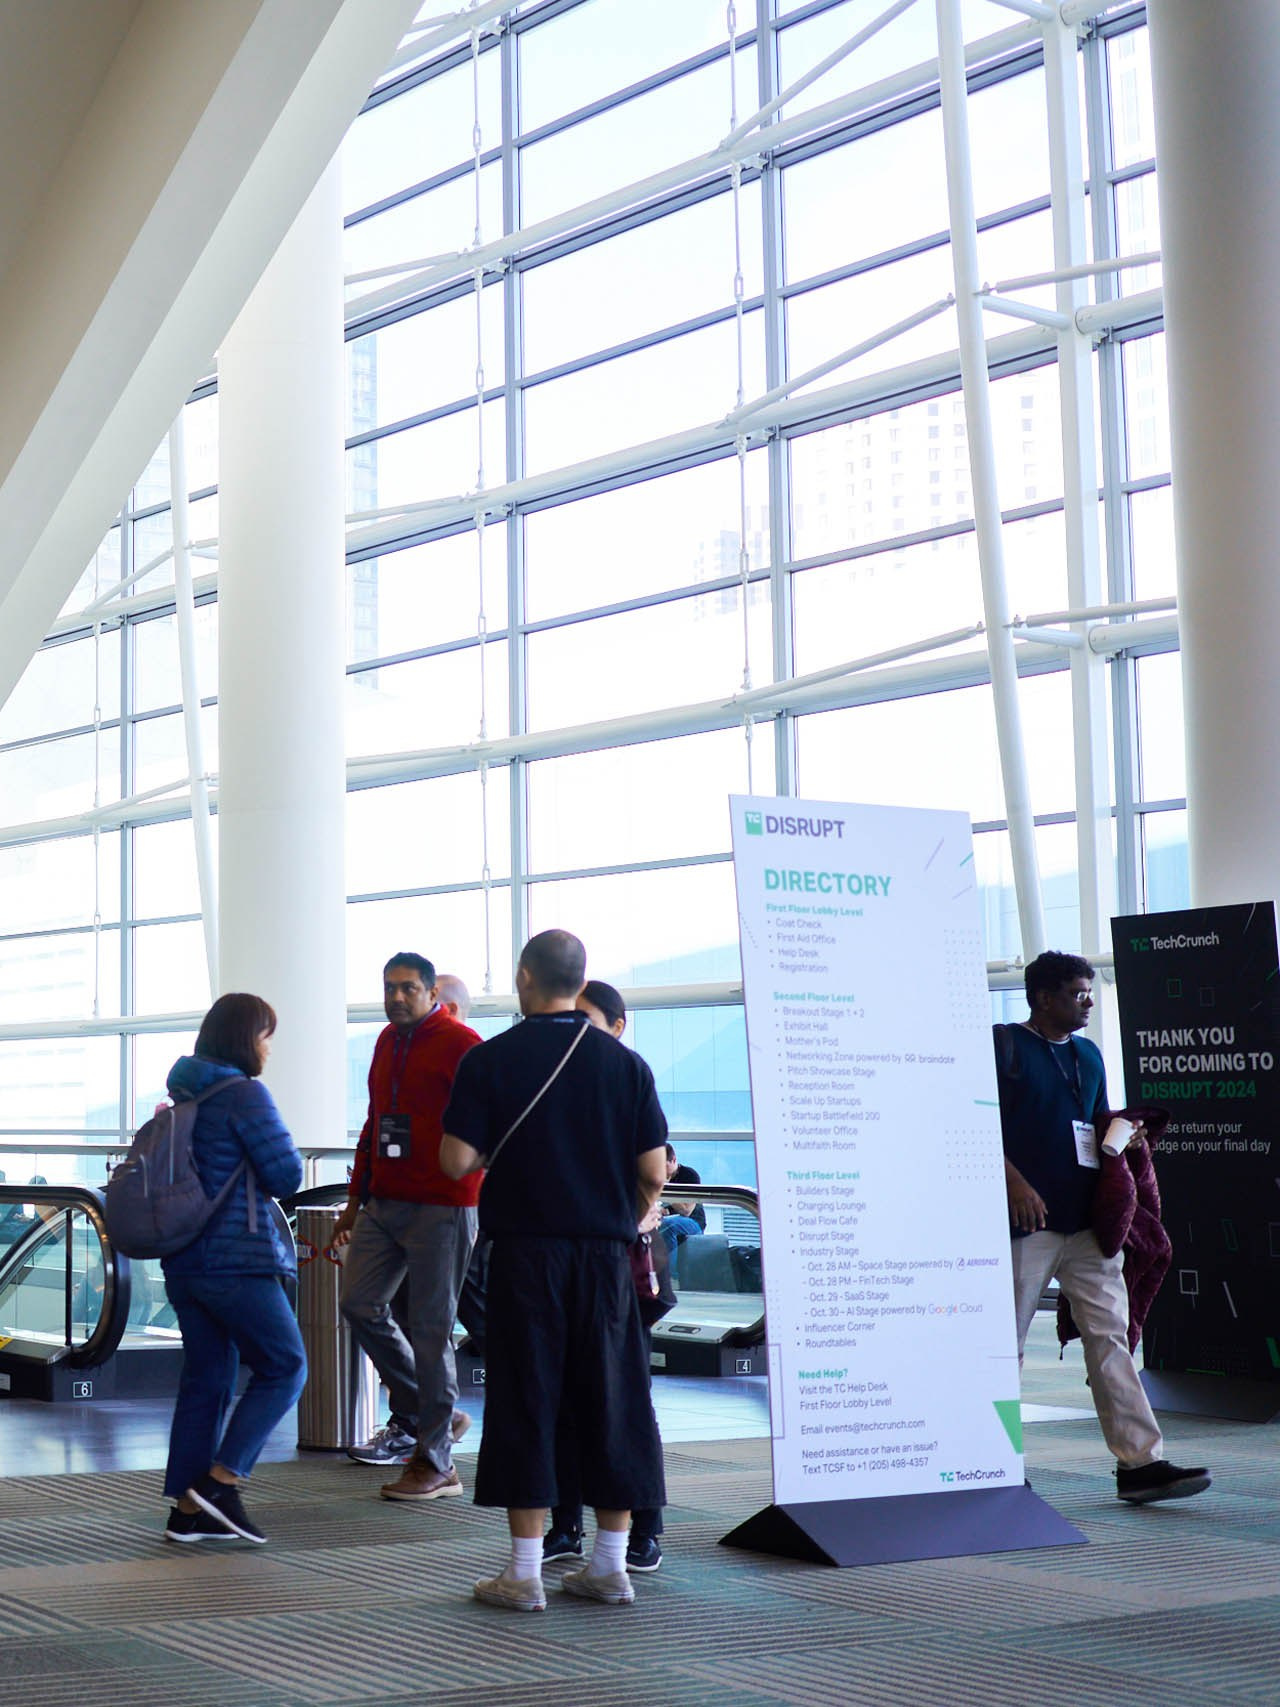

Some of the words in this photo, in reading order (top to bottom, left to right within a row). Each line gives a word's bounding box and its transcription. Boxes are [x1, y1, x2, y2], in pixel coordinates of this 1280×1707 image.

[766, 816, 844, 838] DISRUPT
[764, 869, 891, 896] DIRECTORY
[766, 904, 786, 914] First
[788, 905, 810, 914] Floor
[813, 906, 838, 917] Lobby
[841, 907, 863, 916] Level
[776, 919, 795, 928] Coat
[797, 919, 822, 928] Check
[777, 933, 795, 942] First
[797, 934, 809, 943] Aid
[811, 935, 836, 944] Office
[1131, 938, 1148, 951] TC
[1150, 932, 1219, 949] TechCrunch
[778, 948, 796, 958] Help
[799, 948, 818, 958] Desk
[779, 962, 828, 974] Registration
[774, 992, 805, 1000] Second
[808, 992, 829, 1002] Floor
[832, 993, 854, 1002] Level
[782, 1006, 819, 1016] Breakout
[821, 1008, 844, 1018] Stage
[860, 1009, 864, 1018] 2
[784, 1022, 810, 1030] Exhibit
[813, 1022, 828, 1031] Hall
[785, 1036, 820, 1046] Mother's
[823, 1037, 838, 1046] Pod
[1136, 1029, 1195, 1048] THANK
[1198, 1027, 1234, 1045] YOU
[786, 1051, 832, 1062] Networking
[834, 1052, 854, 1061] Zone
[856, 1053, 890, 1063] powered
[892, 1054, 901, 1064] by
[920, 1056, 954, 1064] braindate
[1140, 1056, 1172, 1073] FOR
[1176, 1054, 1246, 1072] COMING
[1248, 1053, 1273, 1070] TO
[788, 1066, 808, 1075] Pitch
[810, 1067, 851, 1076] Showcase
[853, 1068, 876, 1078] Stage
[789, 1081, 830, 1090] Reception
[832, 1082, 854, 1090] Room
[1141, 1082, 1212, 1098] DISRUPT
[1216, 1080, 1256, 1098] 2024
[790, 1096, 812, 1105] Scale
[814, 1097, 824, 1106] Up
[827, 1098, 862, 1106] Startups
[791, 1112, 820, 1120] Startup
[823, 1112, 863, 1120] Battlefield
[865, 1112, 880, 1120] 200
[792, 1126, 831, 1135] Volunteer
[834, 1127, 858, 1135] Office
[1182, 1124, 1214, 1133] return
[1217, 1124, 1242, 1136] your
[793, 1141, 830, 1150] Multifaith
[832, 1142, 856, 1150] Room
[1182, 1141, 1193, 1150] on
[1195, 1141, 1221, 1154] your
[1224, 1140, 1248, 1150] final
[1250, 1138, 1271, 1154] day
[787, 1172, 810, 1180] Third
[813, 1172, 834, 1180] Floor
[836, 1172, 860, 1180] Level
[796, 1186, 829, 1196] Builders
[832, 1186, 854, 1196] Stage
[797, 1202, 834, 1212] Charging
[836, 1202, 866, 1211] Lounge
[798, 1217, 816, 1226] Deal
[819, 1217, 836, 1225] Flow
[800, 1232, 829, 1242] Disrupt
[832, 1232, 854, 1241] Stage
[800, 1247, 834, 1257] Industry
[836, 1247, 859, 1256] Stage
[808, 1262, 825, 1272] Oct.
[826, 1262, 836, 1270] 28
[838, 1262, 850, 1270] AM
[858, 1260, 882, 1271] Space
[884, 1260, 908, 1270] Stage
[909, 1260, 942, 1270] powered
[944, 1259, 952, 1269] by
[809, 1278, 825, 1286] Oct.
[827, 1277, 837, 1286] 28
[839, 1276, 851, 1285] PM
[859, 1276, 890, 1285] FinTech
[892, 1275, 914, 1286] Stage
[810, 1293, 825, 1302] Oct.
[828, 1292, 838, 1301] 29
[844, 1292, 864, 1301] SaaS
[867, 1291, 889, 1301] Stage
[810, 1308, 826, 1317] Oct.
[828, 1308, 838, 1316] 30
[847, 1306, 854, 1316] AI
[856, 1306, 879, 1316] Stage
[881, 1305, 914, 1316] powered
[916, 1304, 926, 1315] by
[928, 1304, 958, 1315] Google
[960, 1304, 982, 1313] Cloud
[805, 1322, 845, 1332] Influencer
[847, 1322, 876, 1331] Corner
[806, 1338, 856, 1348] Roundtables
[742, 1360, 748, 1372] 4
[798, 1370, 821, 1379] Need
[824, 1368, 848, 1379] Help?
[81, 1382, 88, 1396] 6
[800, 1385, 817, 1394] Visit
[819, 1384, 832, 1394] the
[834, 1384, 845, 1393] TC
[848, 1382, 866, 1393] Help
[868, 1382, 888, 1392] Desk
[800, 1401, 818, 1410] First
[820, 1400, 841, 1409] Floor
[844, 1399, 868, 1410] Lobby
[870, 1398, 892, 1407] Level
[802, 1424, 822, 1434] Email
[825, 1420, 925, 1434] events@techcrunch.com
[802, 1449, 824, 1459] Need
[826, 1446, 869, 1458] assistance
[882, 1444, 900, 1454] have
[914, 1442, 938, 1452] issue?
[803, 1464, 820, 1474] Text
[823, 1462, 844, 1472] TCSF
[847, 1462, 855, 1472] to
[858, 1461, 866, 1470] +1
[870, 1460, 888, 1471] (205)
[891, 1458, 928, 1468] 498-4357
[940, 1472, 954, 1482] TC
[956, 1468, 1005, 1480] TechCrunch
